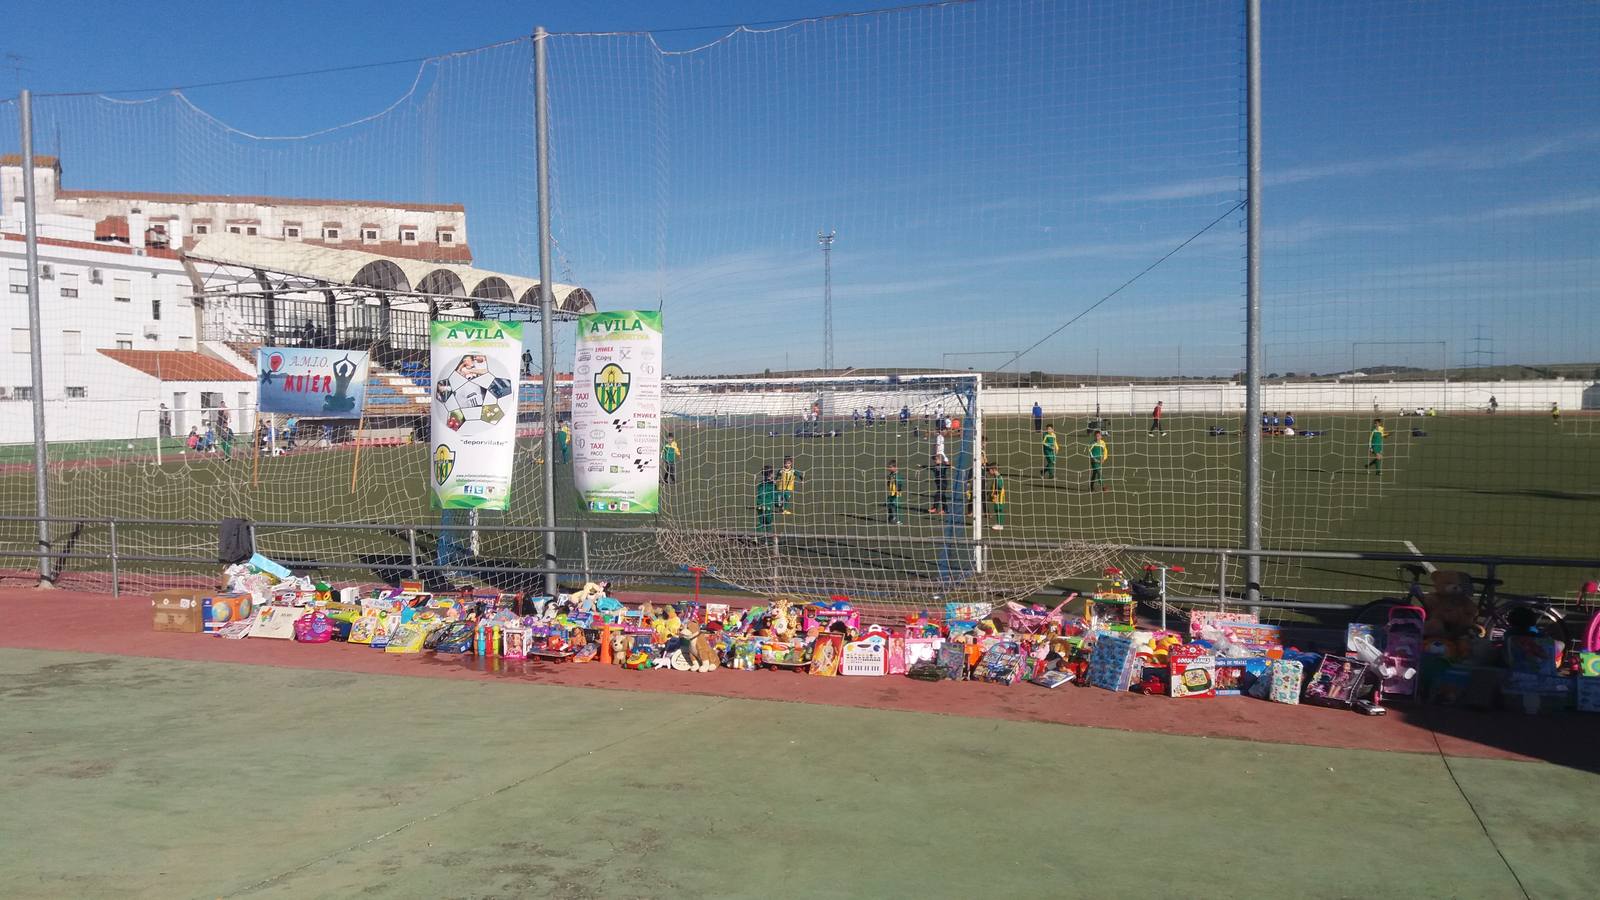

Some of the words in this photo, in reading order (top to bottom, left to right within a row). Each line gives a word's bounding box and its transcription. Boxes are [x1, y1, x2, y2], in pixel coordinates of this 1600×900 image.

[591, 321, 600, 333] A
[604, 320, 644, 331] VILA
[447, 328, 458, 340] A
[464, 328, 505, 340] VILA
[575, 393, 589, 401] TAXI
[590, 442, 605, 450] TAXI
